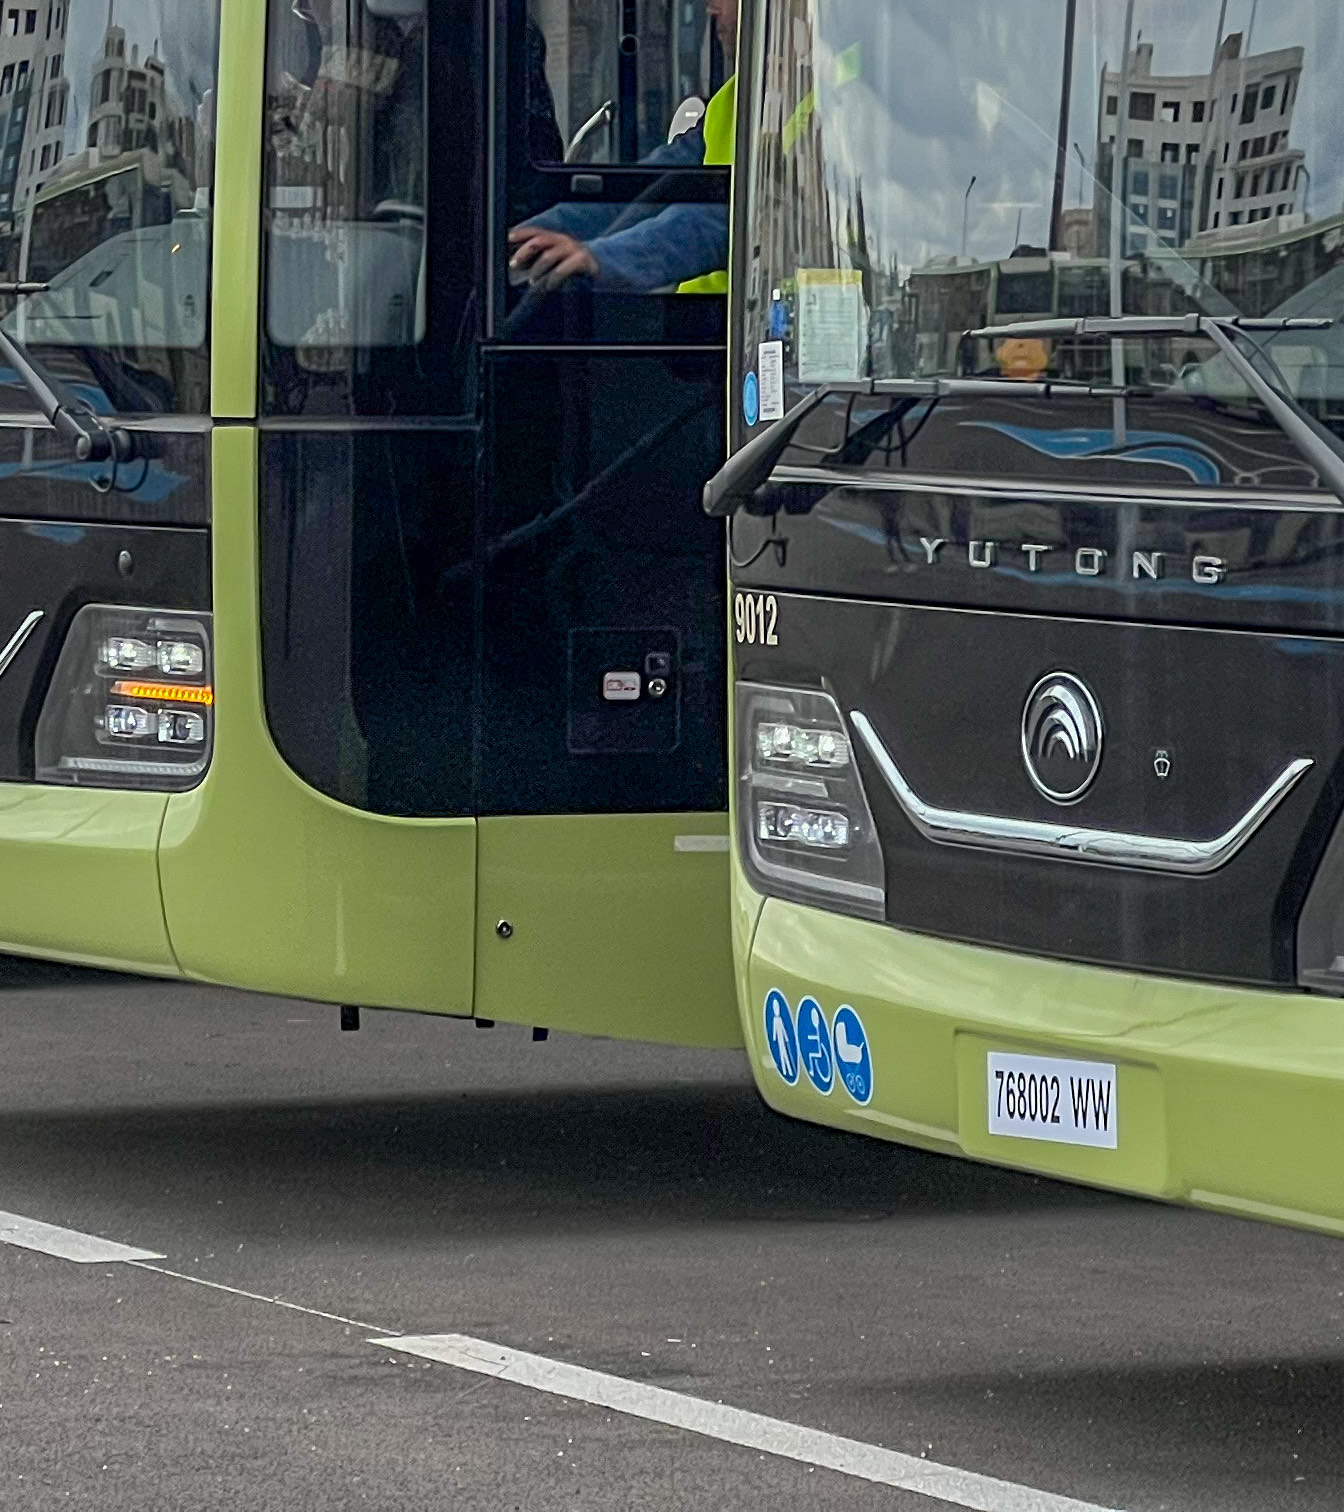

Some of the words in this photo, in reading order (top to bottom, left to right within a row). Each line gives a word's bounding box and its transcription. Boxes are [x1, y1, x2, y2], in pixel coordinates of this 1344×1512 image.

[919, 537, 1229, 585] YUTONG
[735, 593, 779, 646] 9012
[995, 1070, 1061, 1124] 768002
[1069, 1076, 1111, 1132] WW
